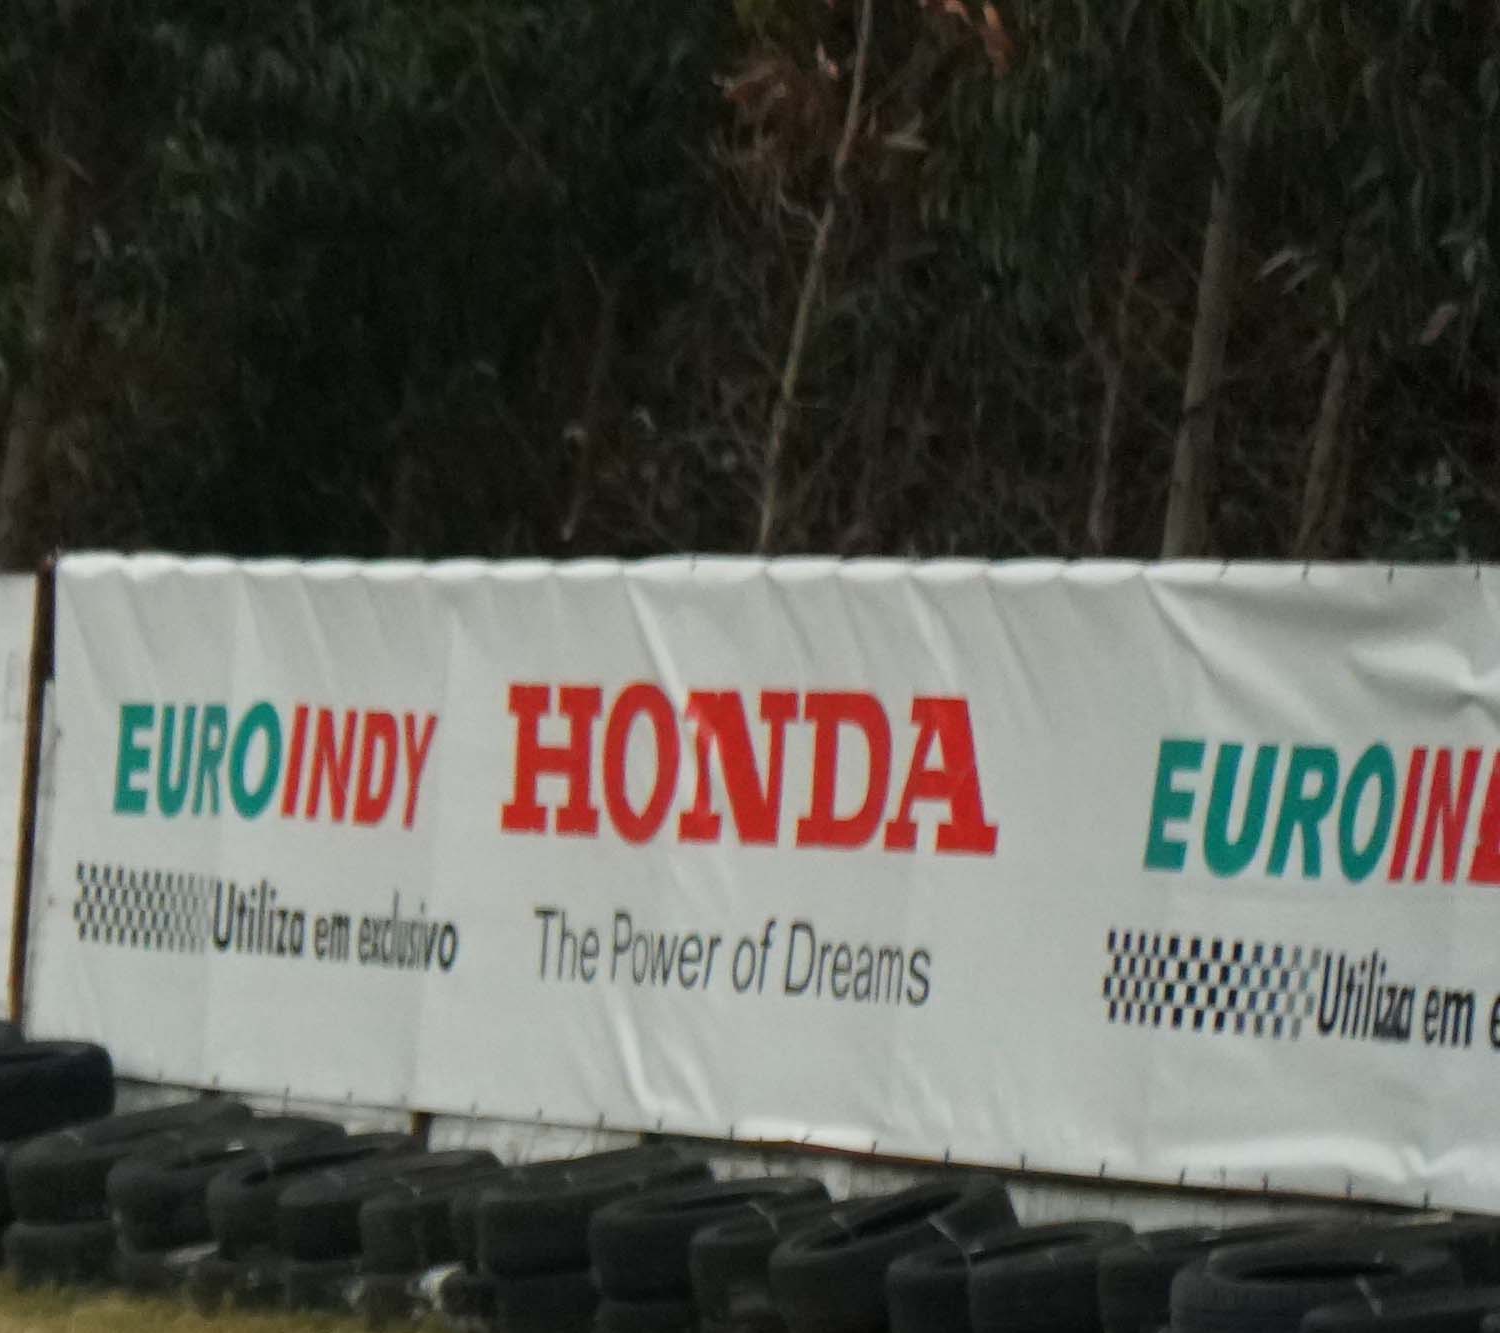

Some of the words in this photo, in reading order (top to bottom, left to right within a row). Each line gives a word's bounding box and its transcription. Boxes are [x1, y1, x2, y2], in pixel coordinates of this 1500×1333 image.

[113, 700, 438, 833] EUROINDY
[500, 683, 998, 857] HONDA
[212, 877, 307, 958] Utiliza
[314, 911, 354, 963] em
[357, 890, 462, 973] exclusivo
[534, 905, 601, 983] The
[610, 910, 722, 991] Power
[732, 918, 777, 995] of
[784, 920, 934, 1008] Dreams
[1316, 948, 1416, 1044] Utiliza
[1422, 984, 1477, 1049] em
